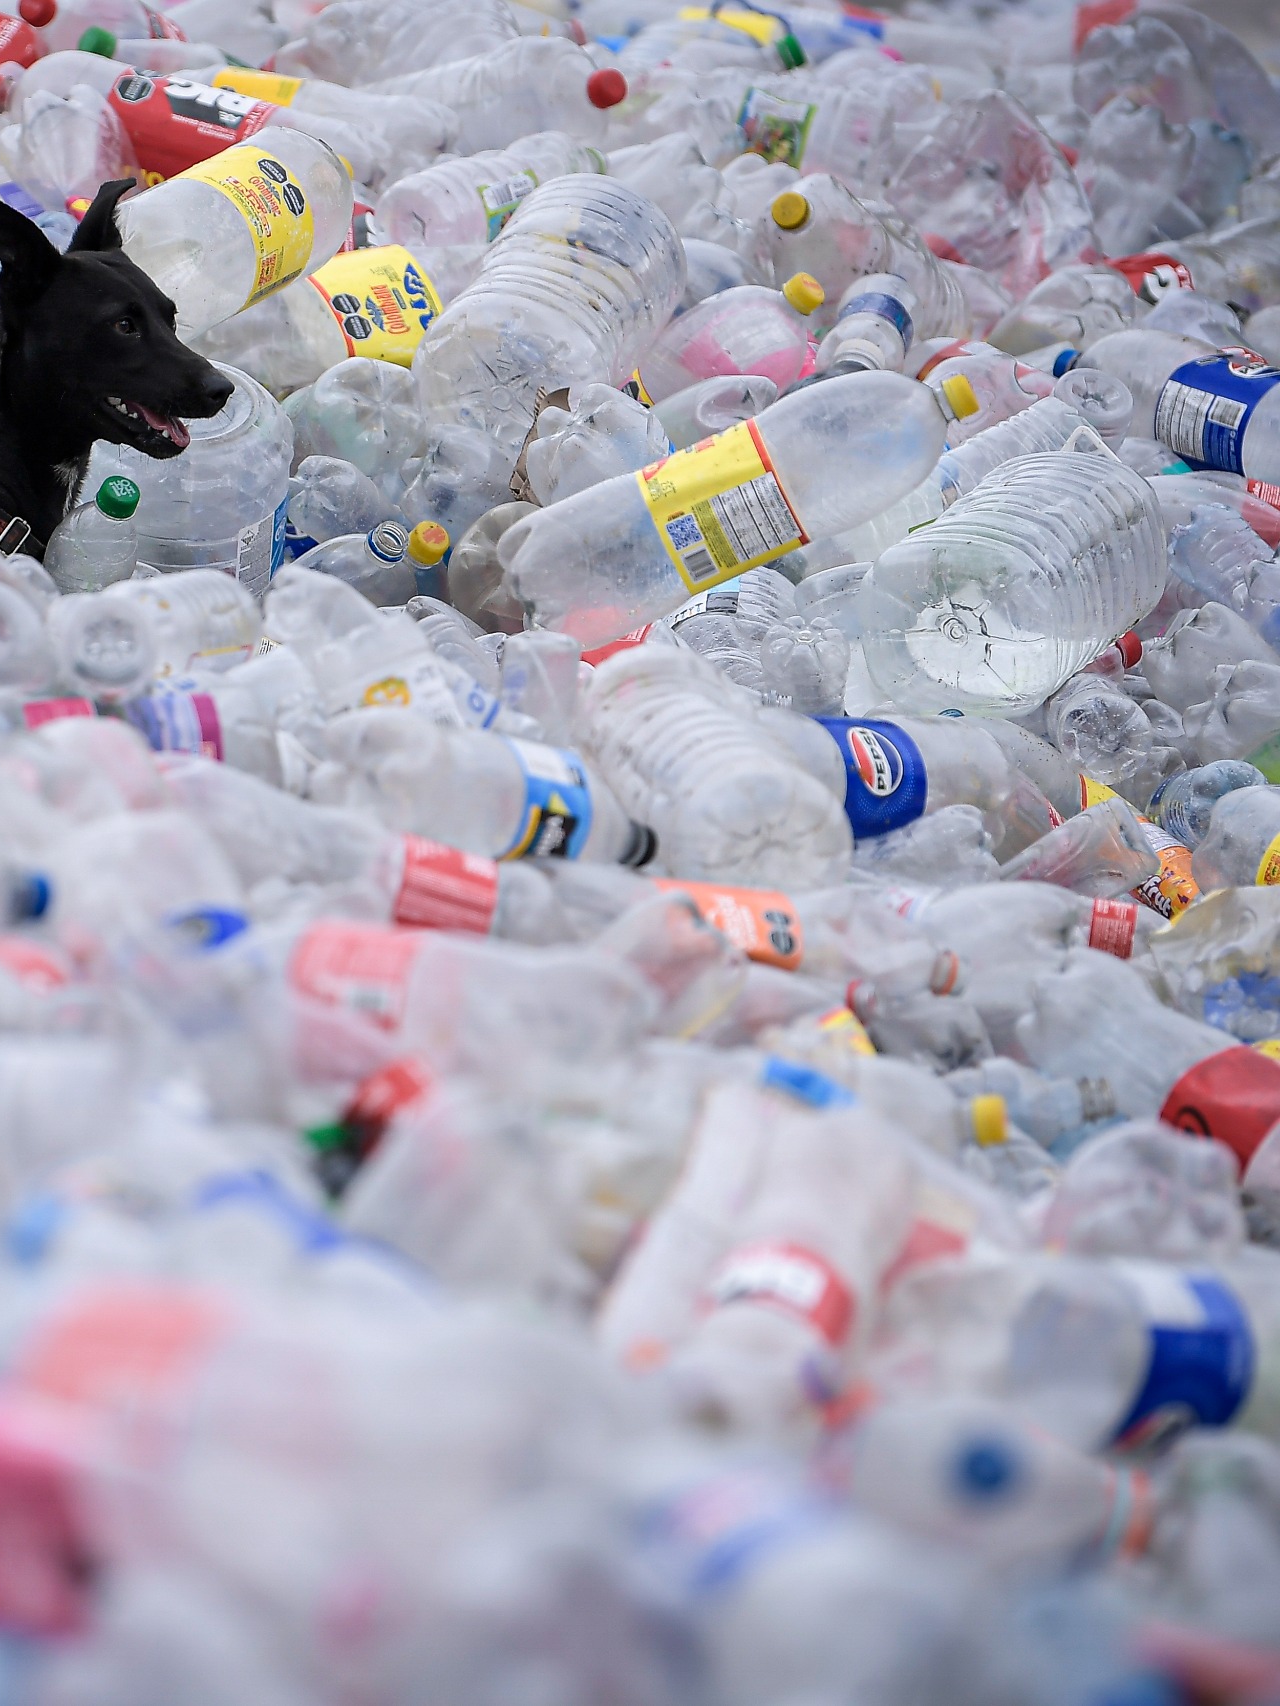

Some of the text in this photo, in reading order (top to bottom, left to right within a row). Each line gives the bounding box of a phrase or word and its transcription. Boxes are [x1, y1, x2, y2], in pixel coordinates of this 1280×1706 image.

[247, 175, 282, 218] Colombiana
[370, 284, 411, 335] Colombiana
[859, 730, 888, 790] PEPSI
